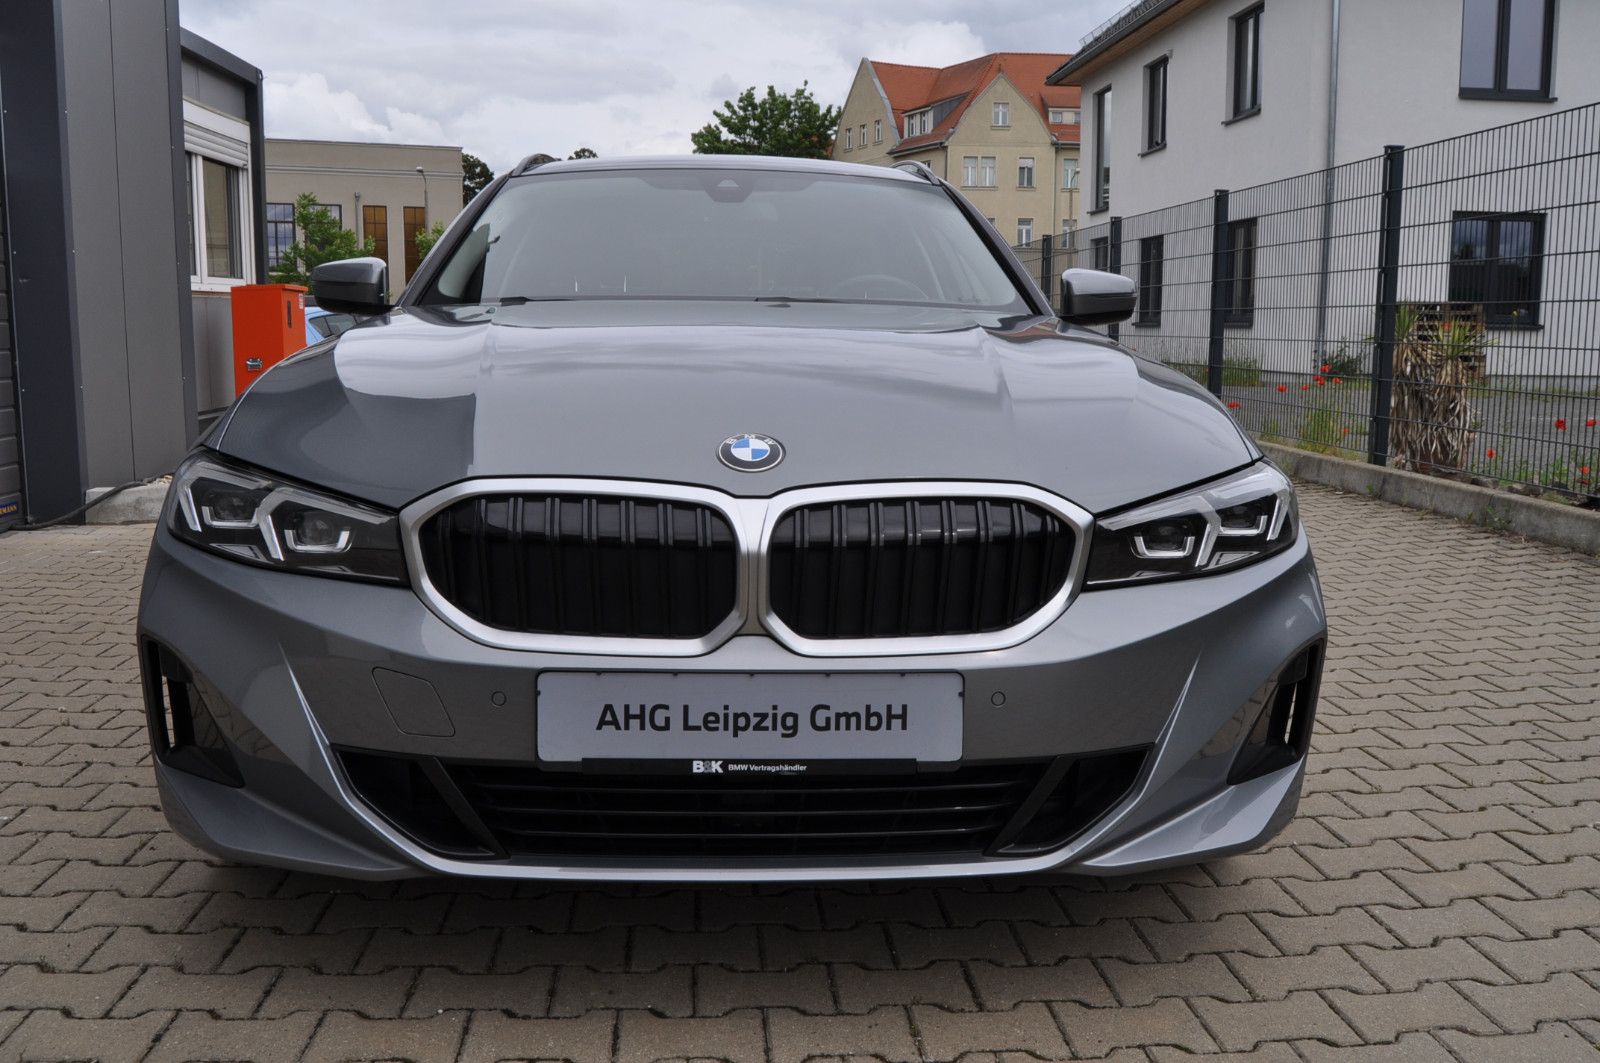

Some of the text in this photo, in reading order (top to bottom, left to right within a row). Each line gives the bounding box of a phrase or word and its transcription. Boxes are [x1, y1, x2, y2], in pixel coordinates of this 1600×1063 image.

[596, 703, 908, 738] AHG Leipzig GmbH
[692, 760, 723, 773] B&K
[749, 763, 807, 773] Vertragshändler
